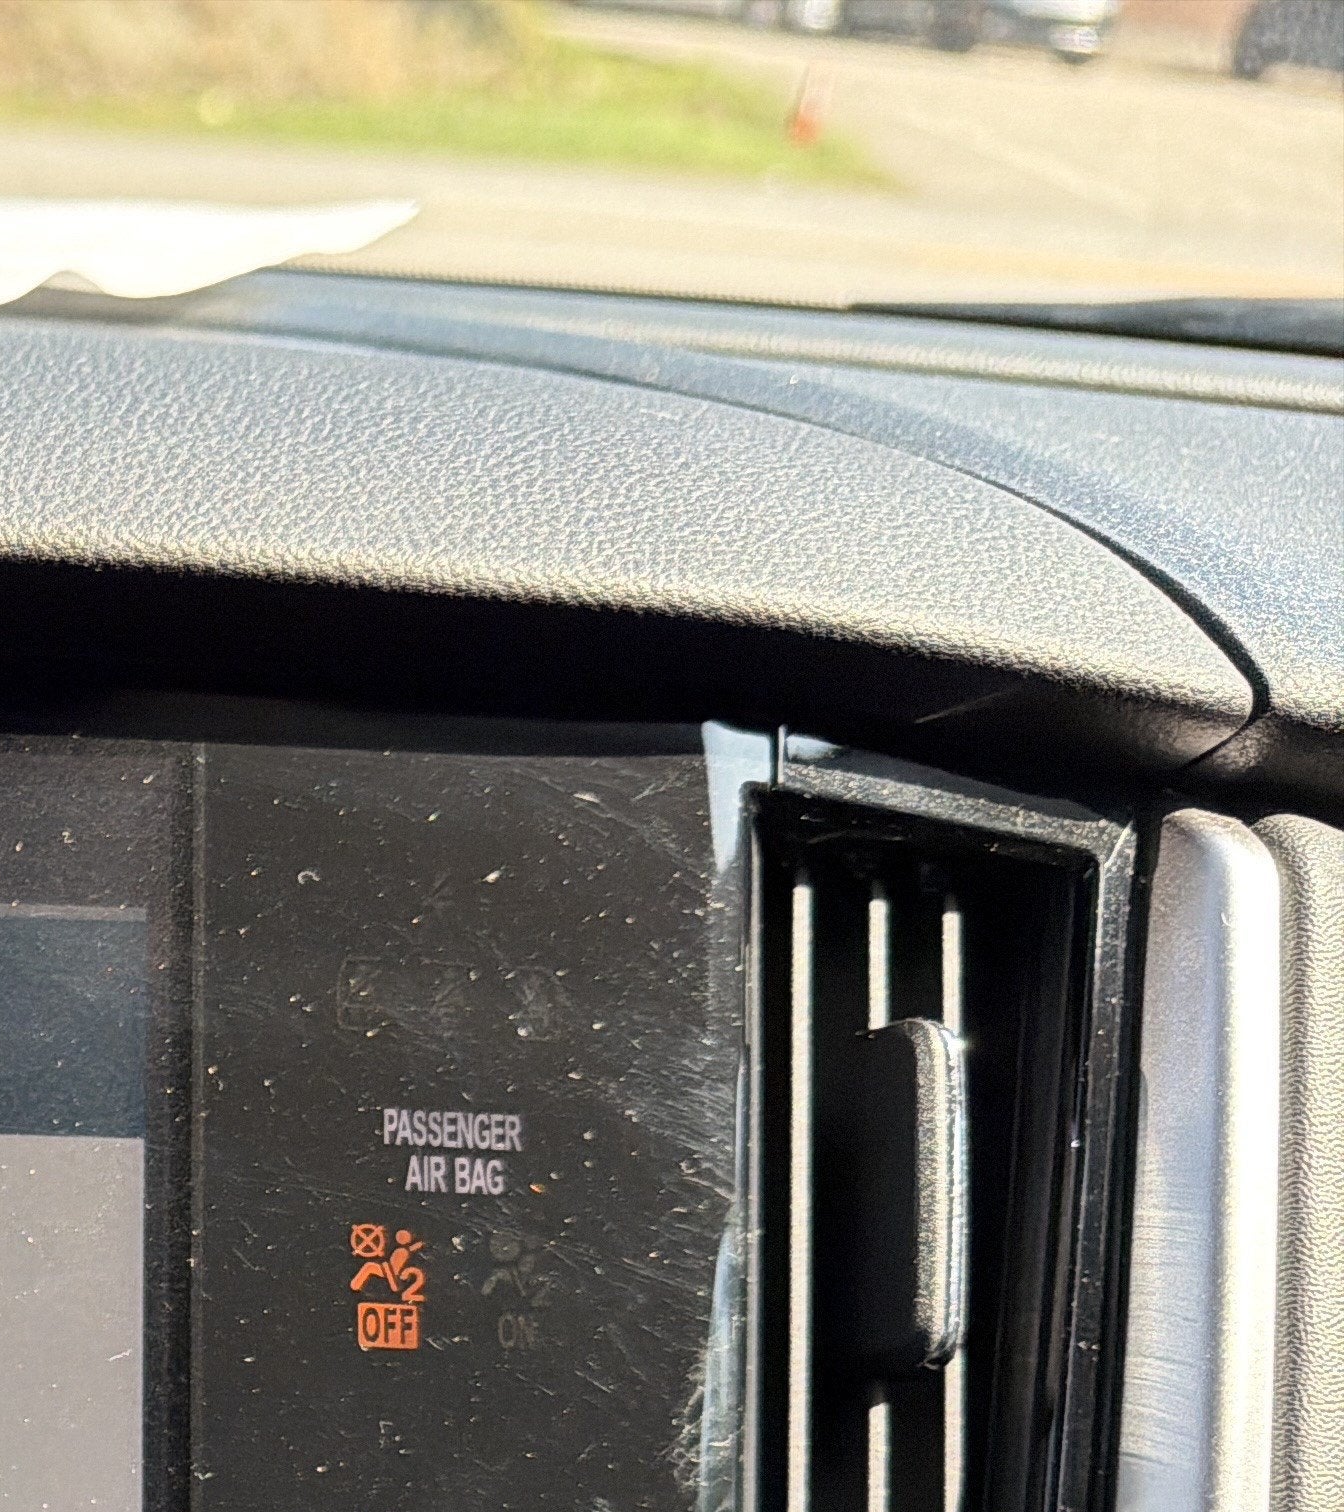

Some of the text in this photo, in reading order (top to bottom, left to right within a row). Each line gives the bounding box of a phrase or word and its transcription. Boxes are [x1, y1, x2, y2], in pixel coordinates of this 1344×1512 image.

[383, 1108, 523, 1152] PASSENGER
[405, 1155, 505, 1196] AIR BAG
[359, 1305, 416, 1347] OFF
